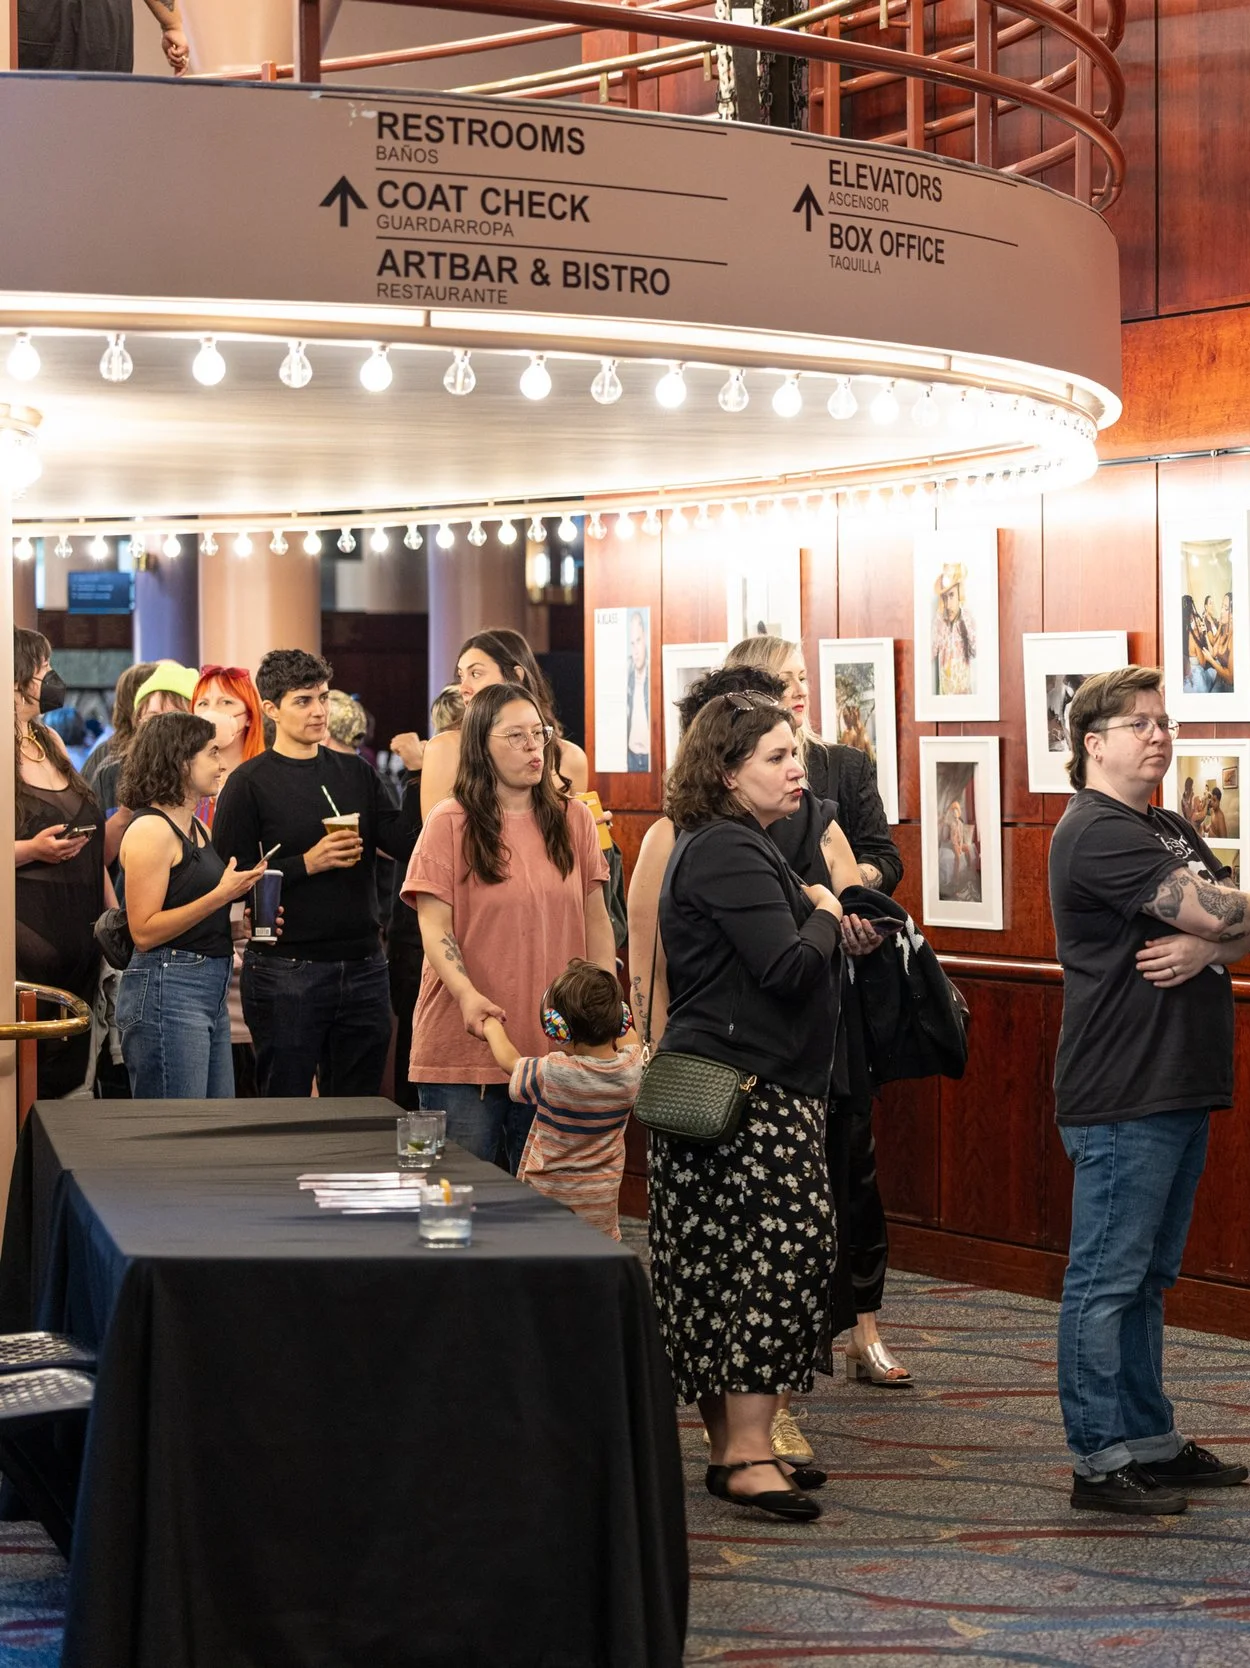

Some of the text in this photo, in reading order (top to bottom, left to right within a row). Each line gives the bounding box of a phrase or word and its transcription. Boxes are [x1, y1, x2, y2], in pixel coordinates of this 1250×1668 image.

[377, 111, 586, 156] RESTROOMS
[376, 145, 439, 165] BAÑOS
[828, 159, 943, 203] ELEVATORS
[377, 180, 591, 223] COAT CHECK
[828, 191, 890, 213] ASCENSOR
[376, 214, 515, 238] GUARDARROPA
[829, 222, 946, 265] BOX OFFICE
[376, 248, 671, 296] ARTBAR & BISTRO
[829, 254, 882, 275] TAQUILLA
[376, 283, 509, 305] RESTAURANTE
